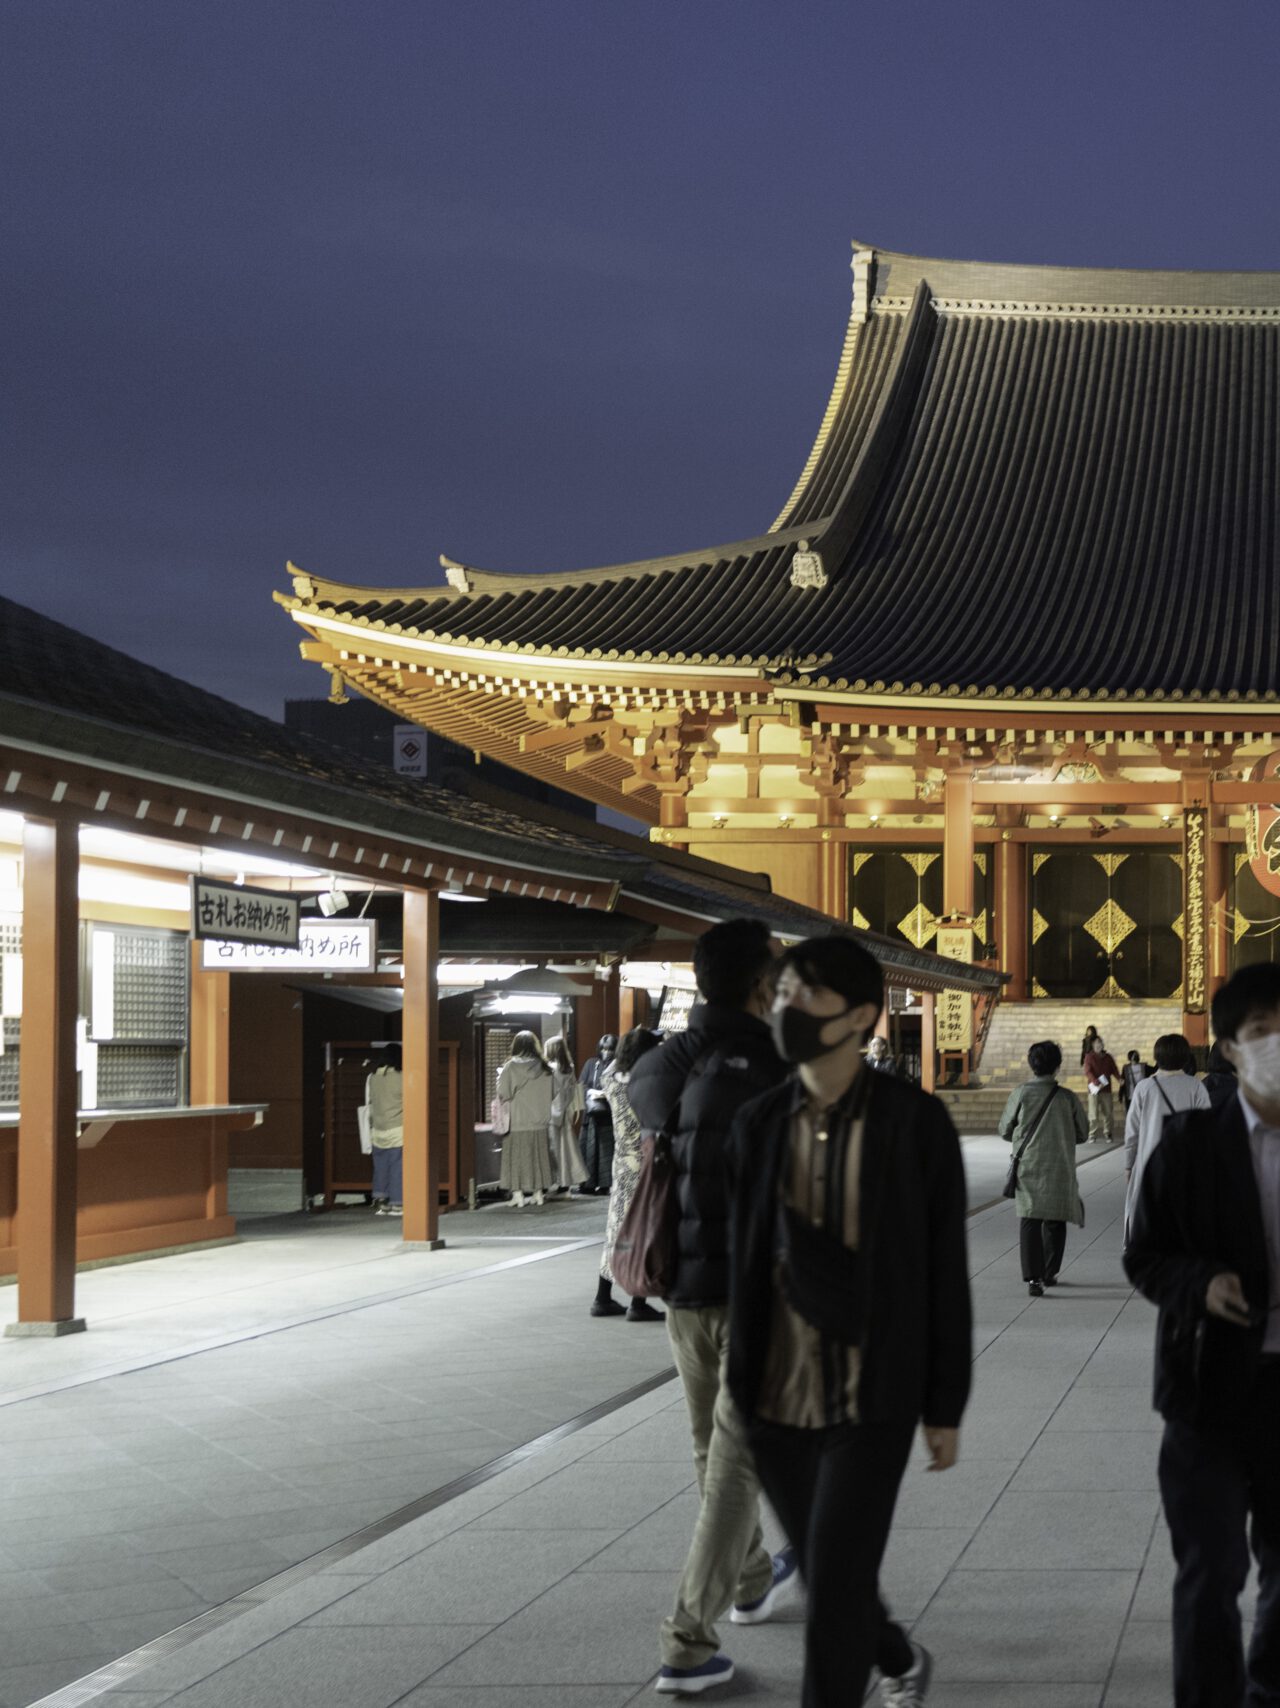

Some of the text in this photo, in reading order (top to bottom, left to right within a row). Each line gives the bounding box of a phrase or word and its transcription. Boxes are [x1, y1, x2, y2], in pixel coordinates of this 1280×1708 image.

[200, 893, 291, 935] 古札お納め所
